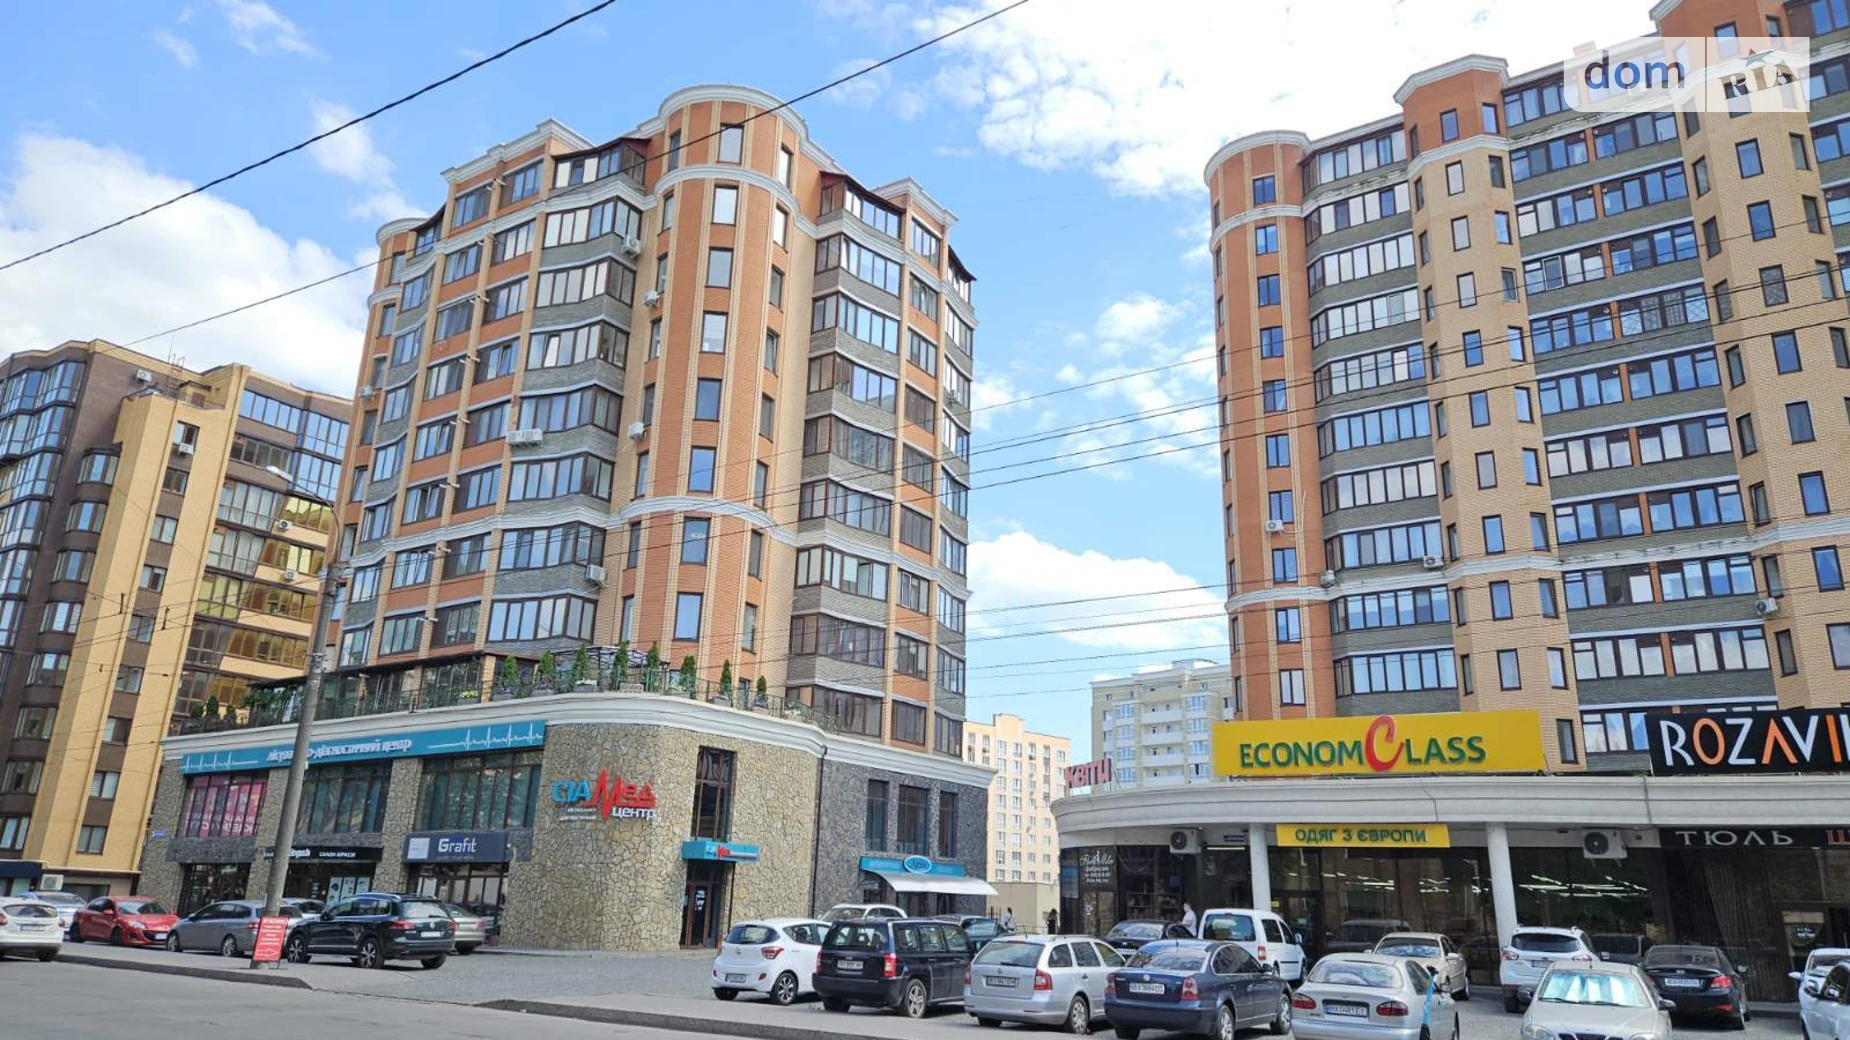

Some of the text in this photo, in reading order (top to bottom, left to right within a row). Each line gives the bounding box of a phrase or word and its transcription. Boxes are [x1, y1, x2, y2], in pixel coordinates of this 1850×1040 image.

[1239, 715, 1488, 772] ECONOMCLASS
[1065, 757, 1112, 788] КВІТИ
[612, 806, 656, 821] центр
[1295, 829, 1339, 844] ОДЯГ
[1356, 829, 1428, 843] ЄВРОПИ
[1675, 829, 1794, 846] ТЮЛЬ
[437, 837, 478, 853] Grafit
